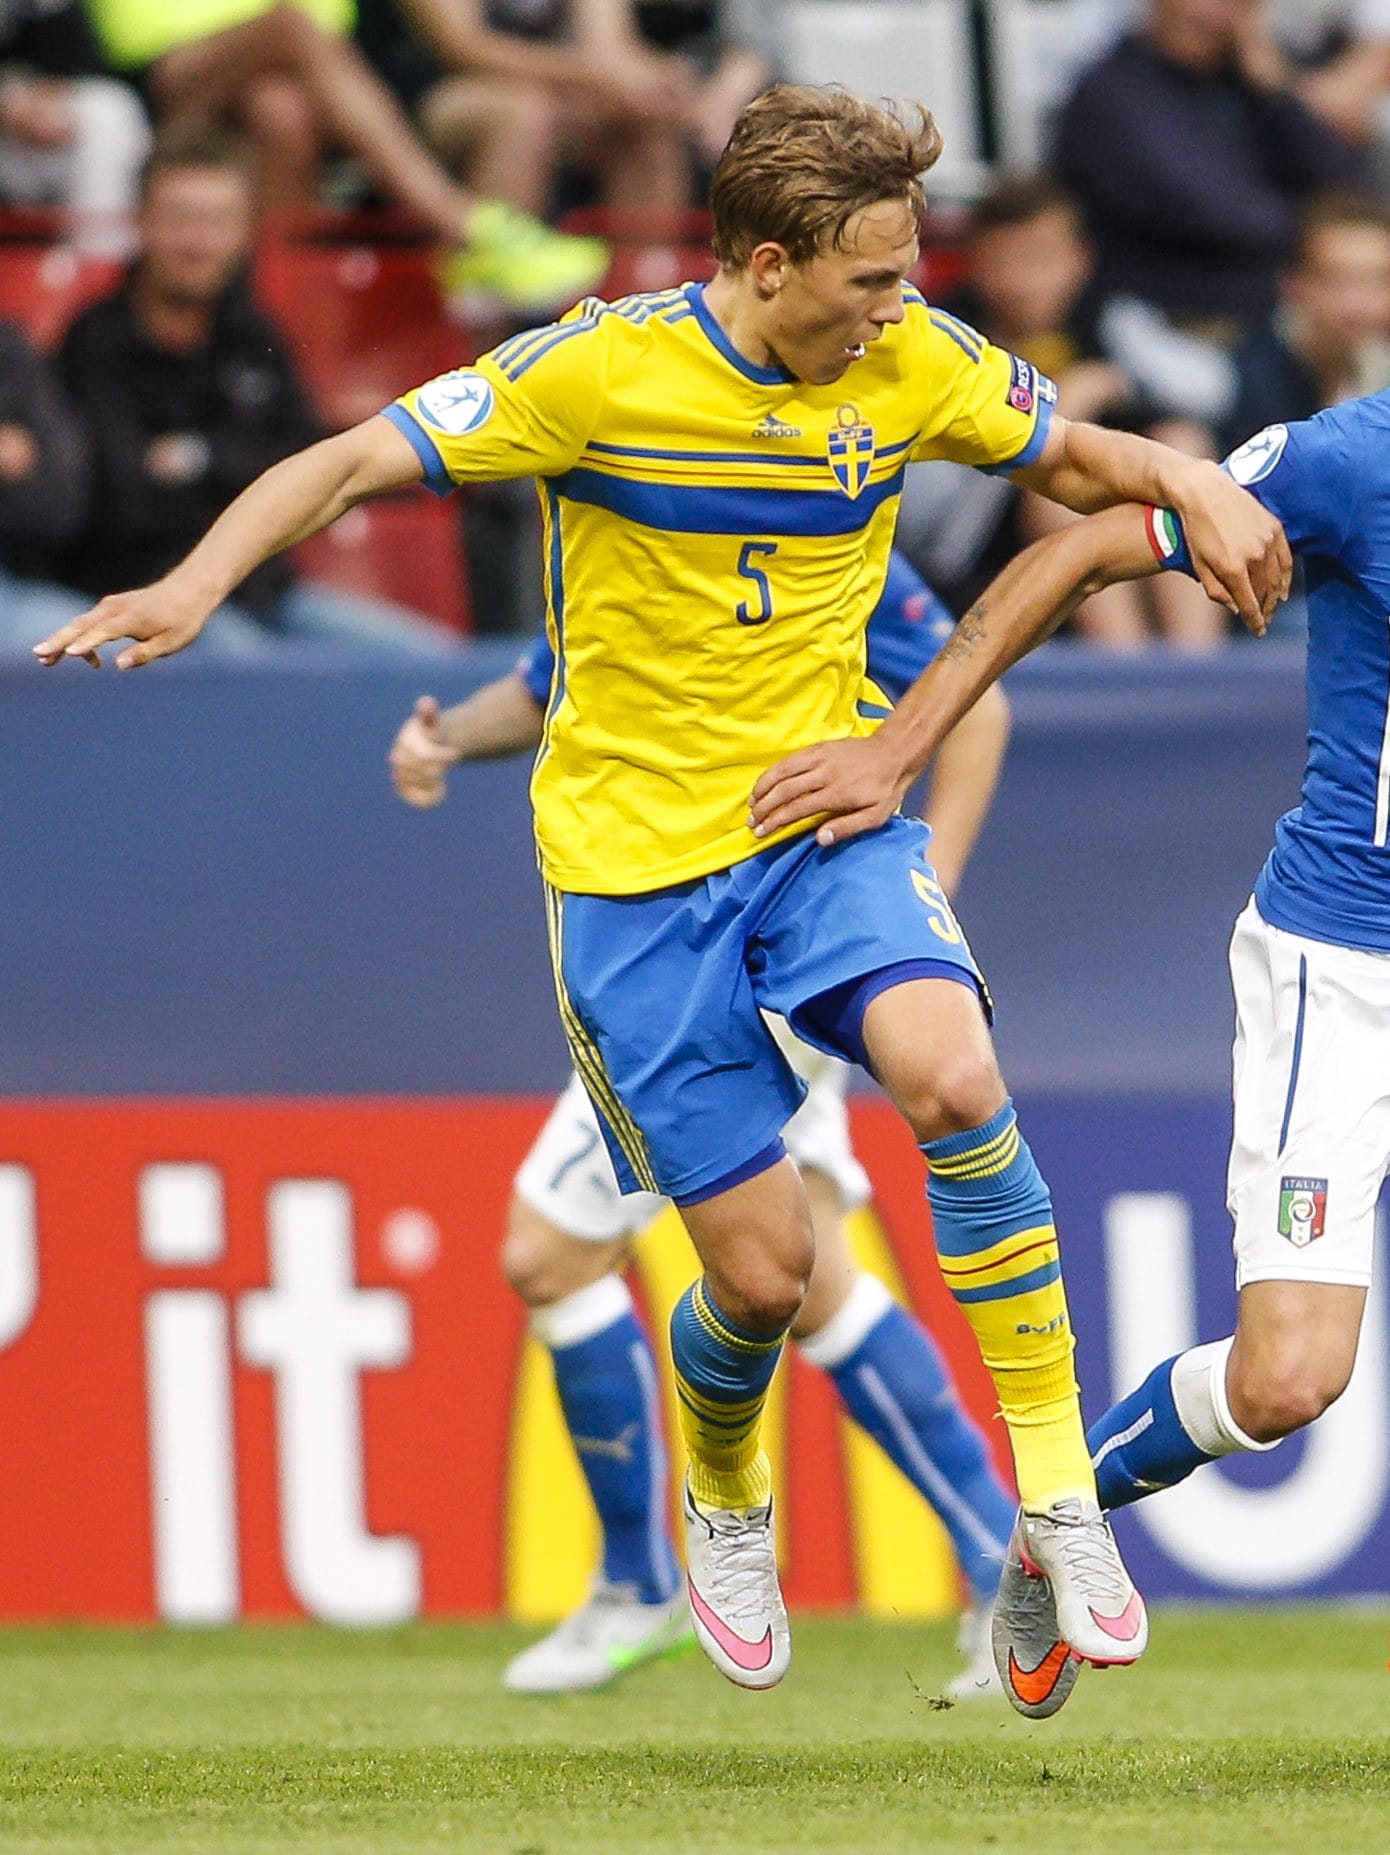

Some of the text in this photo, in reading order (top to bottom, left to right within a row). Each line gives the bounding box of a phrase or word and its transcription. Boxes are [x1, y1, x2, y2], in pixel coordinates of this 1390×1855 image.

[751, 427, 803, 440] adidas
[735, 541, 778, 626] 5
[909, 868, 961, 945] 5
[1283, 1179, 1324, 1191] ITALIA
[136, 1158, 424, 1628] it
